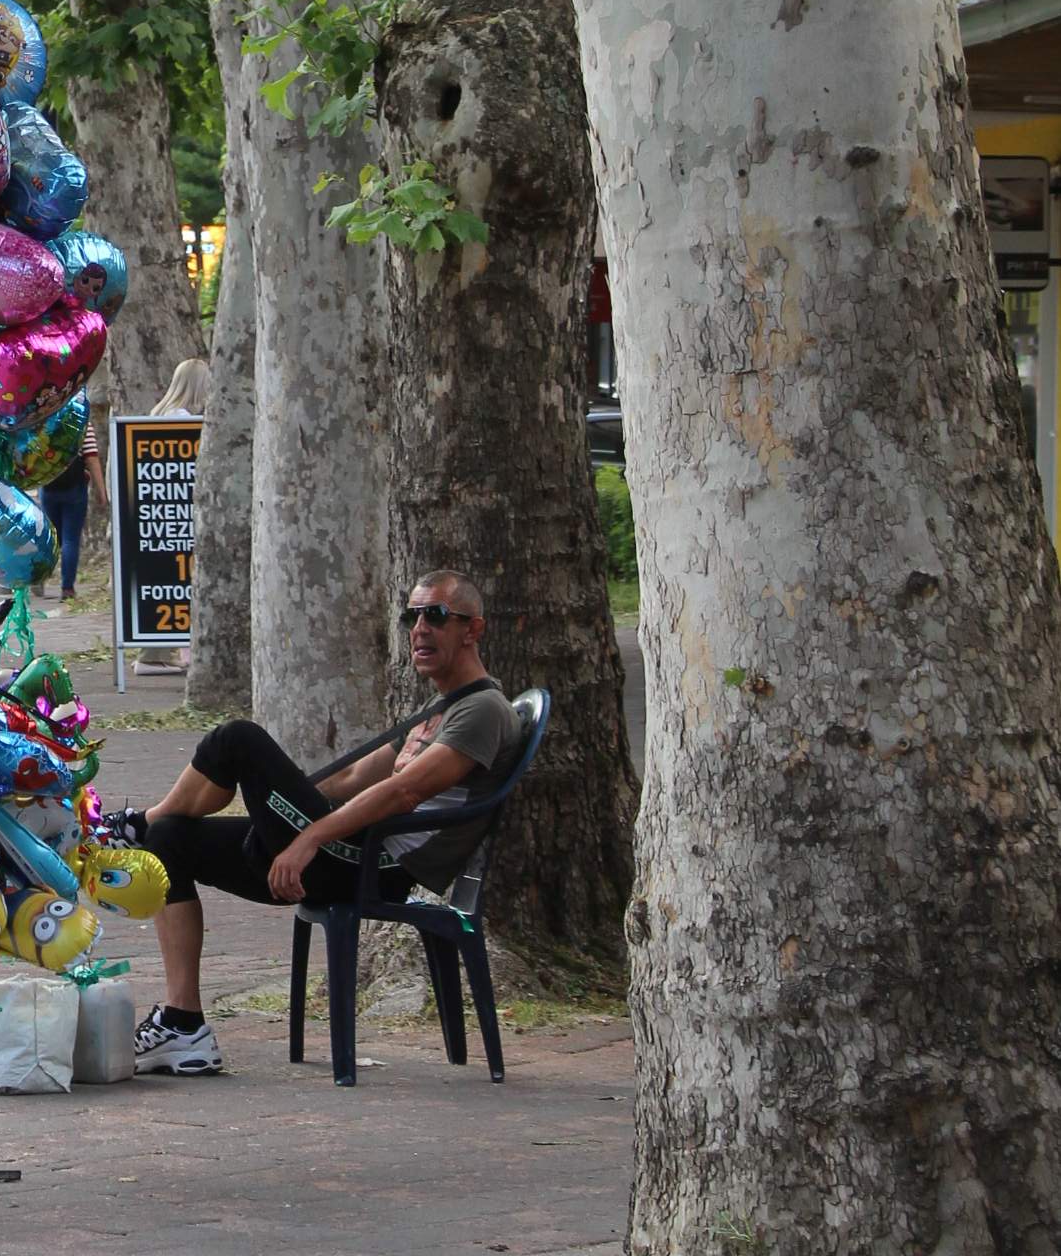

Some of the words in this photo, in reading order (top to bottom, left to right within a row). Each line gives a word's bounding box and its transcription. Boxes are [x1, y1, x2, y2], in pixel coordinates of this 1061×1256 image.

[139, 521, 195, 538] UVEZI
[139, 539, 195, 552] PLASTIF
[156, 604, 190, 630] 25
